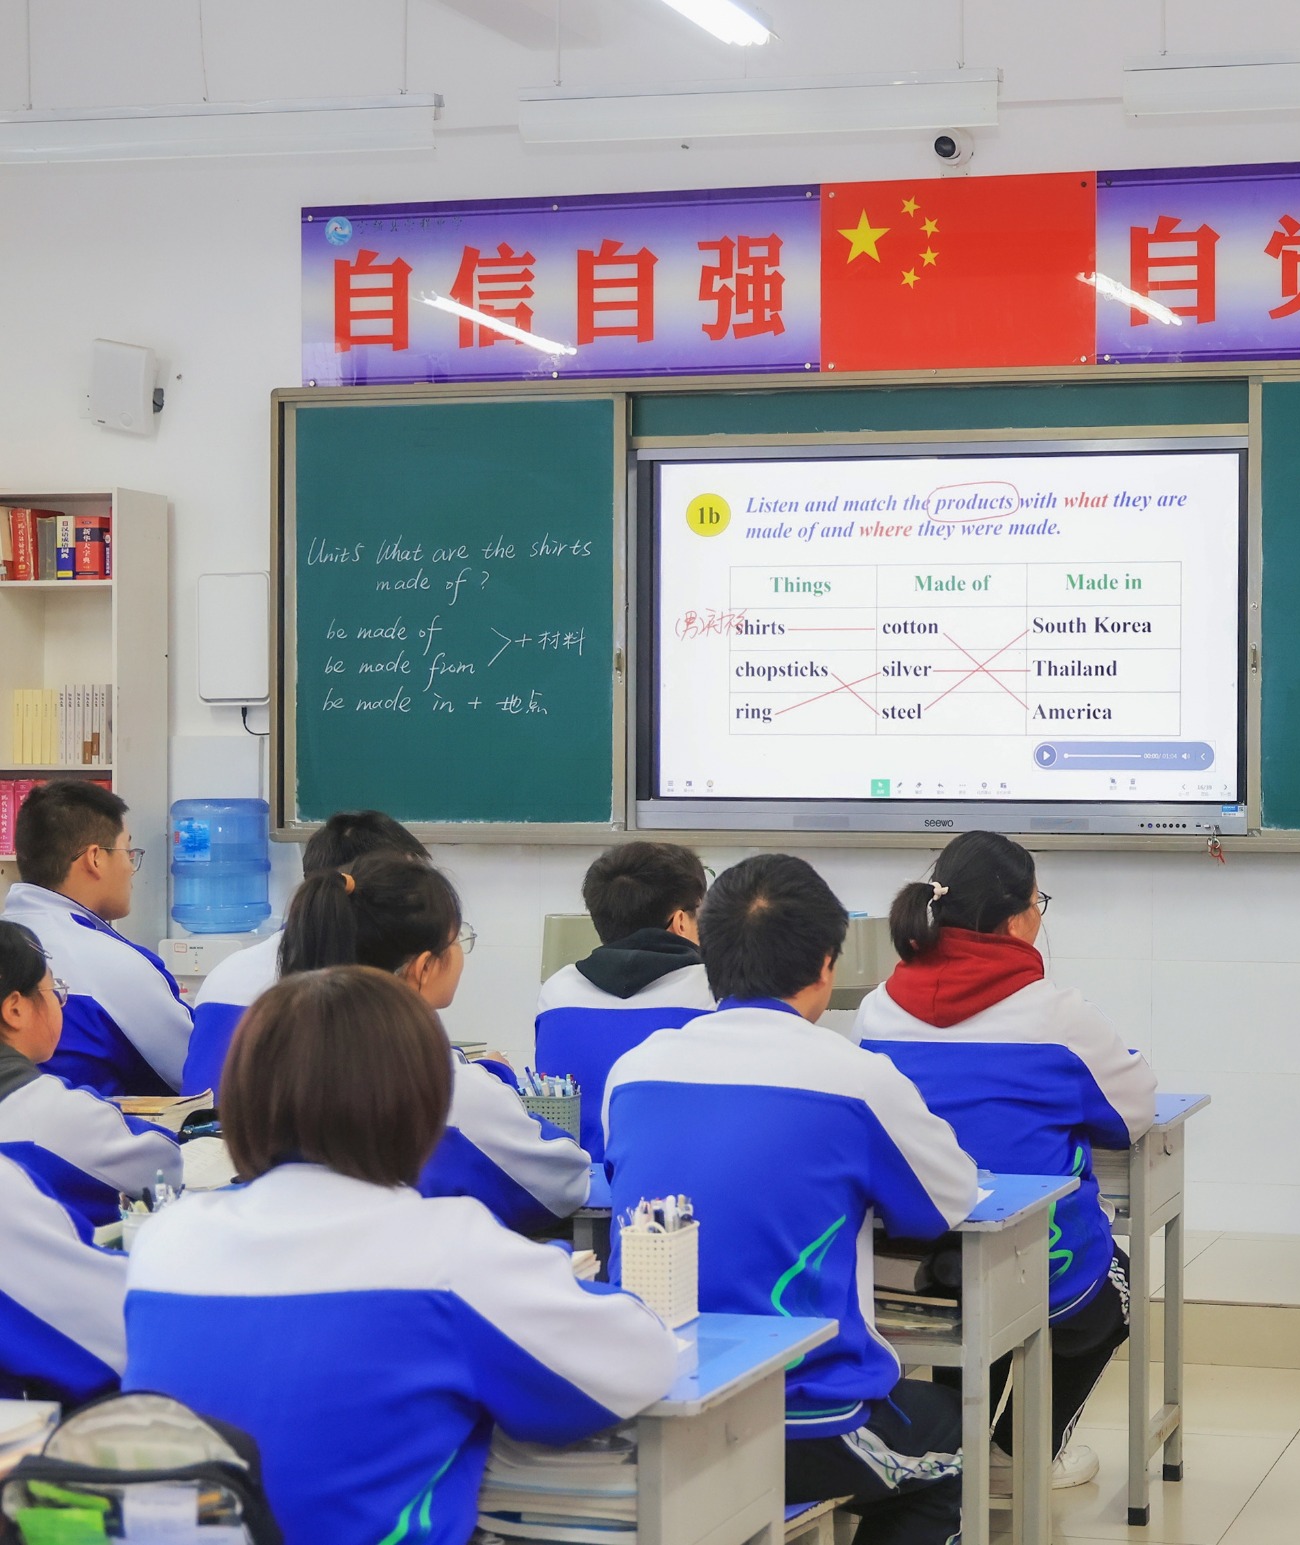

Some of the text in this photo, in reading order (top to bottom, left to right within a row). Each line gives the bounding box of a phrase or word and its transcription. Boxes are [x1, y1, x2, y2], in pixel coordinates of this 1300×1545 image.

[334, 233, 785, 352] 自信自强
[746, 491, 1188, 515] Listen and match the products with what they are
[699, 507, 720, 524] 1b
[745, 518, 1061, 543] made of and where they were made.
[376, 535, 424, 564] What
[432, 545, 470, 562] are
[481, 535, 516, 560] the
[529, 532, 592, 558] shirts
[375, 568, 431, 591] made
[445, 567, 472, 606] of
[770, 576, 832, 595] Things
[915, 574, 992, 592] Made of
[1066, 572, 1142, 591] Made in
[735, 619, 785, 635] shirts
[882, 620, 939, 635] cotton
[1032, 616, 1152, 634] South Korea
[326, 615, 444, 656] be made of
[324, 649, 476, 692] be made from
[735, 660, 829, 681] chopsticks
[882, 660, 932, 677] silver
[1032, 660, 1117, 677] Thailand
[322, 687, 345, 711] be
[355, 686, 412, 712] made
[432, 692, 455, 712] in
[736, 703, 772, 722] ring
[882, 703, 922, 720] steel
[1032, 703, 1112, 720] America
[924, 819, 954, 829] seewo
